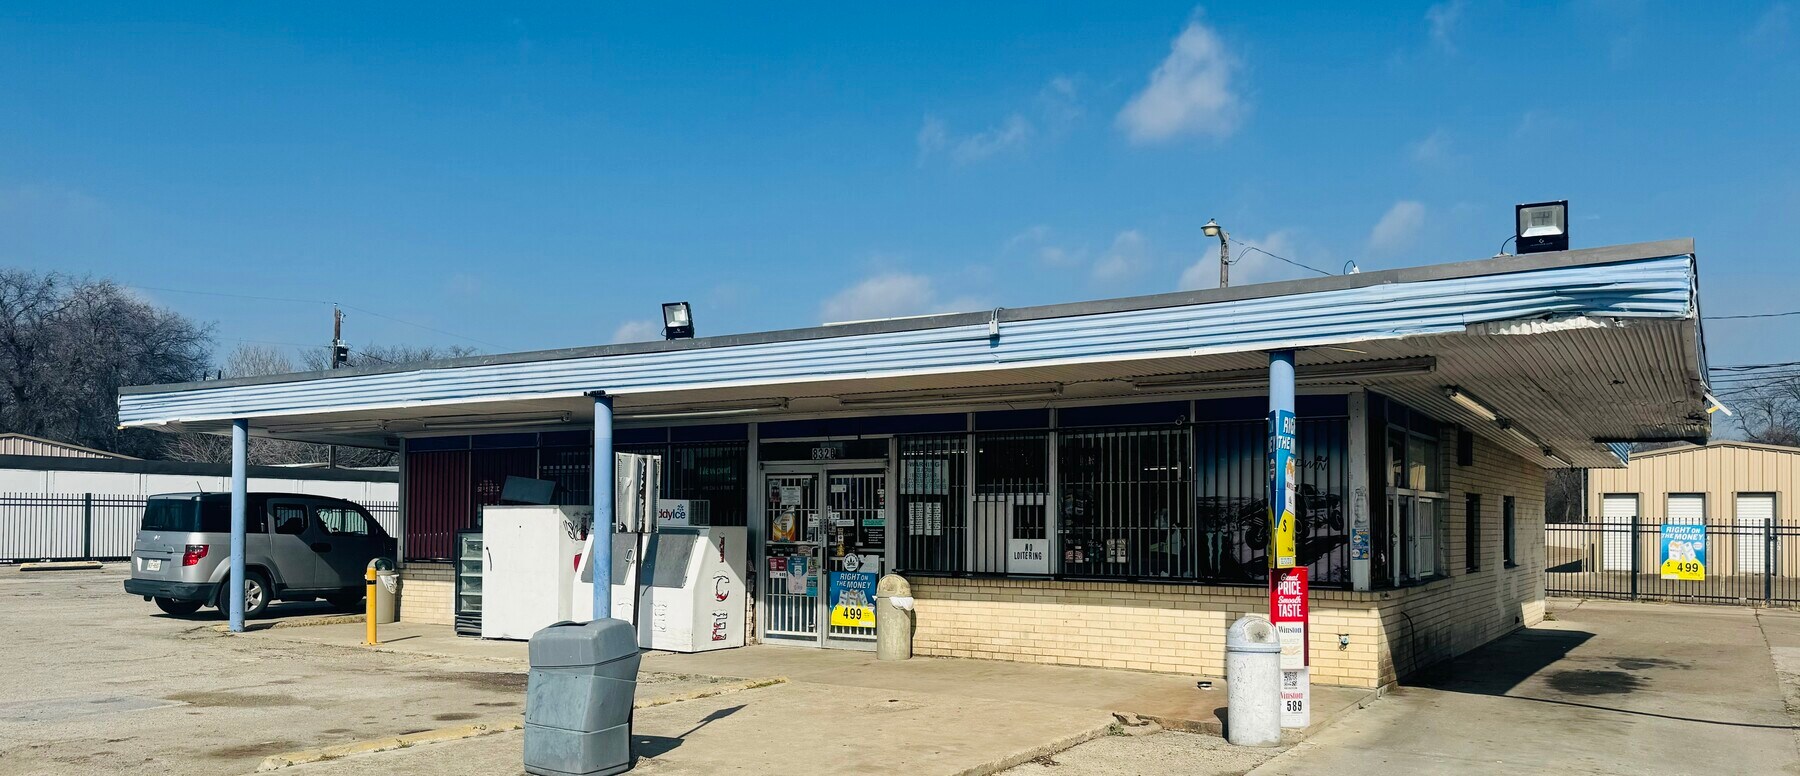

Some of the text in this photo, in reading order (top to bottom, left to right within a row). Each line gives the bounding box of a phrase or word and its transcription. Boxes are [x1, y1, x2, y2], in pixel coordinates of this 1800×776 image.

[1278, 436, 1291, 450] THE
[1674, 533, 1704, 541] MONEY
[1025, 543, 1033, 551] NO
[1014, 552, 1042, 560] LOITERING
[1281, 573, 1299, 581] Great
[846, 581, 872, 589] MONEY
[1278, 595, 1302, 604] Smooth
[843, 607, 862, 620] 499
[1278, 625, 1302, 634] Winston
[1286, 700, 1302, 712] 589
